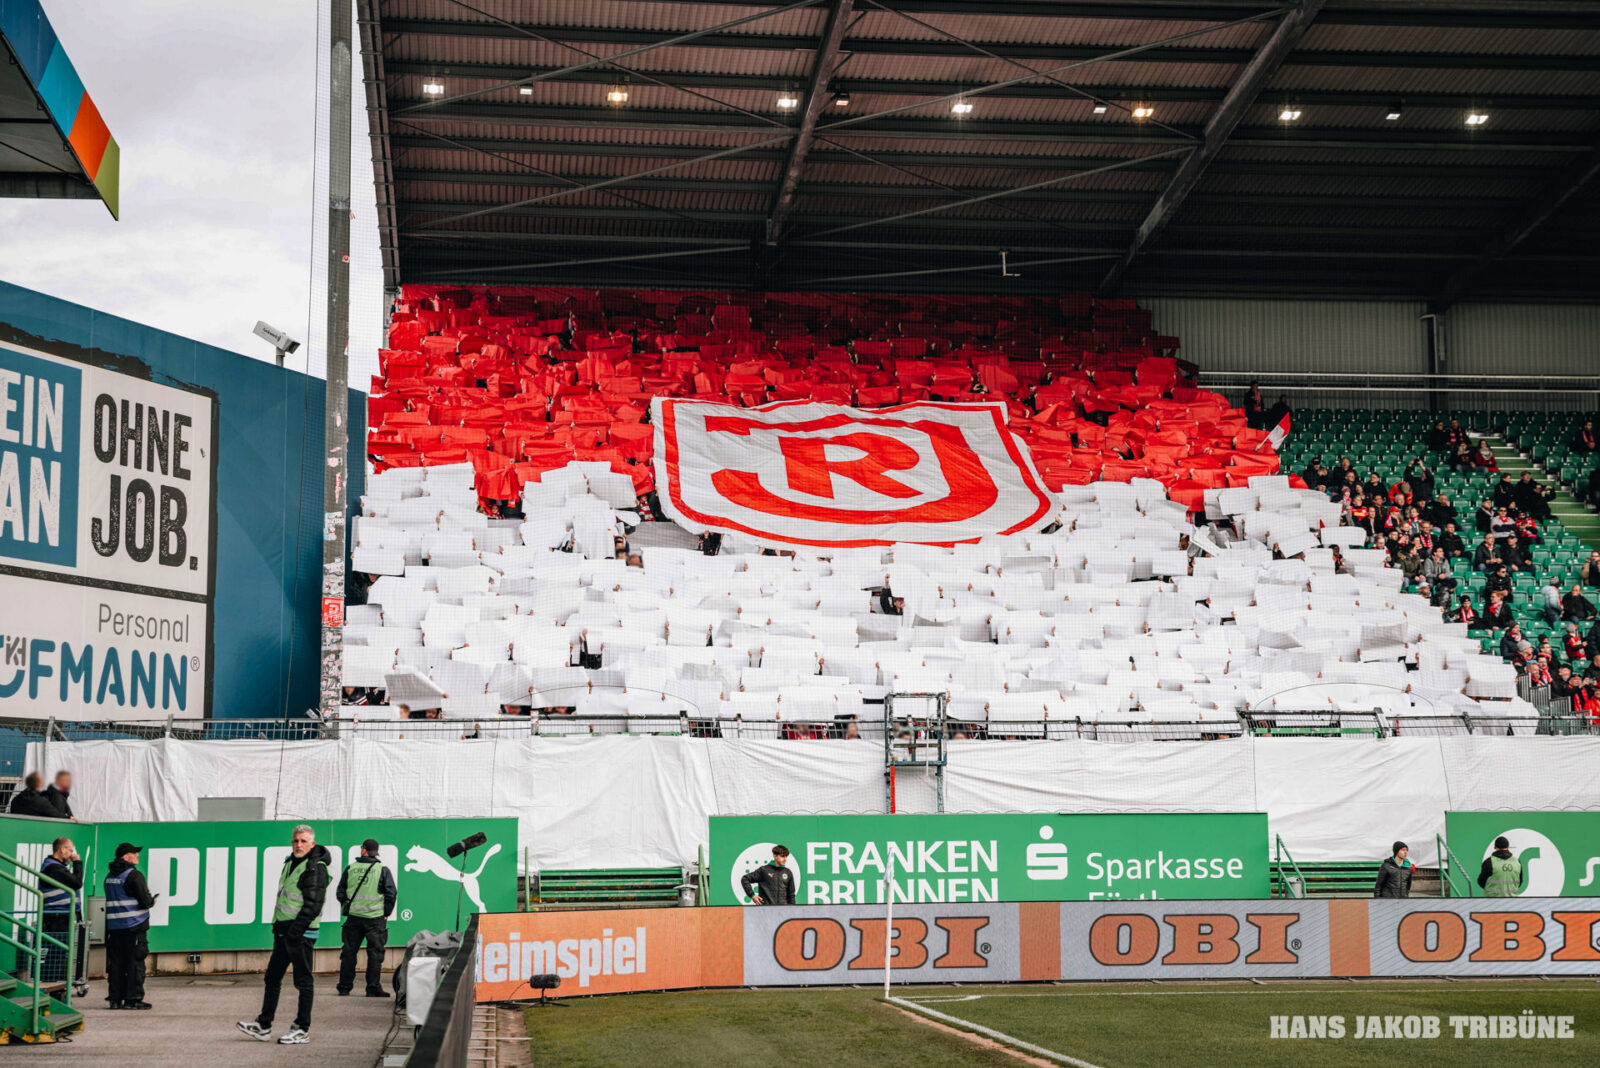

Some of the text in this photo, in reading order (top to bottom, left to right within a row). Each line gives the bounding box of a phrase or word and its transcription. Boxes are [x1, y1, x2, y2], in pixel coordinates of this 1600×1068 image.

[93, 393, 192, 481] OHNE
[91, 474, 198, 571] JOB.
[98, 603, 189, 643] Personal
[806, 840, 998, 874] FRANKEN
[1086, 850, 1244, 887] Sparkasse
[1501, 863, 1513, 872] 60
[773, 916, 990, 971] OBI
[1089, 913, 1300, 966] OBI
[1397, 911, 1600, 963] OBI
